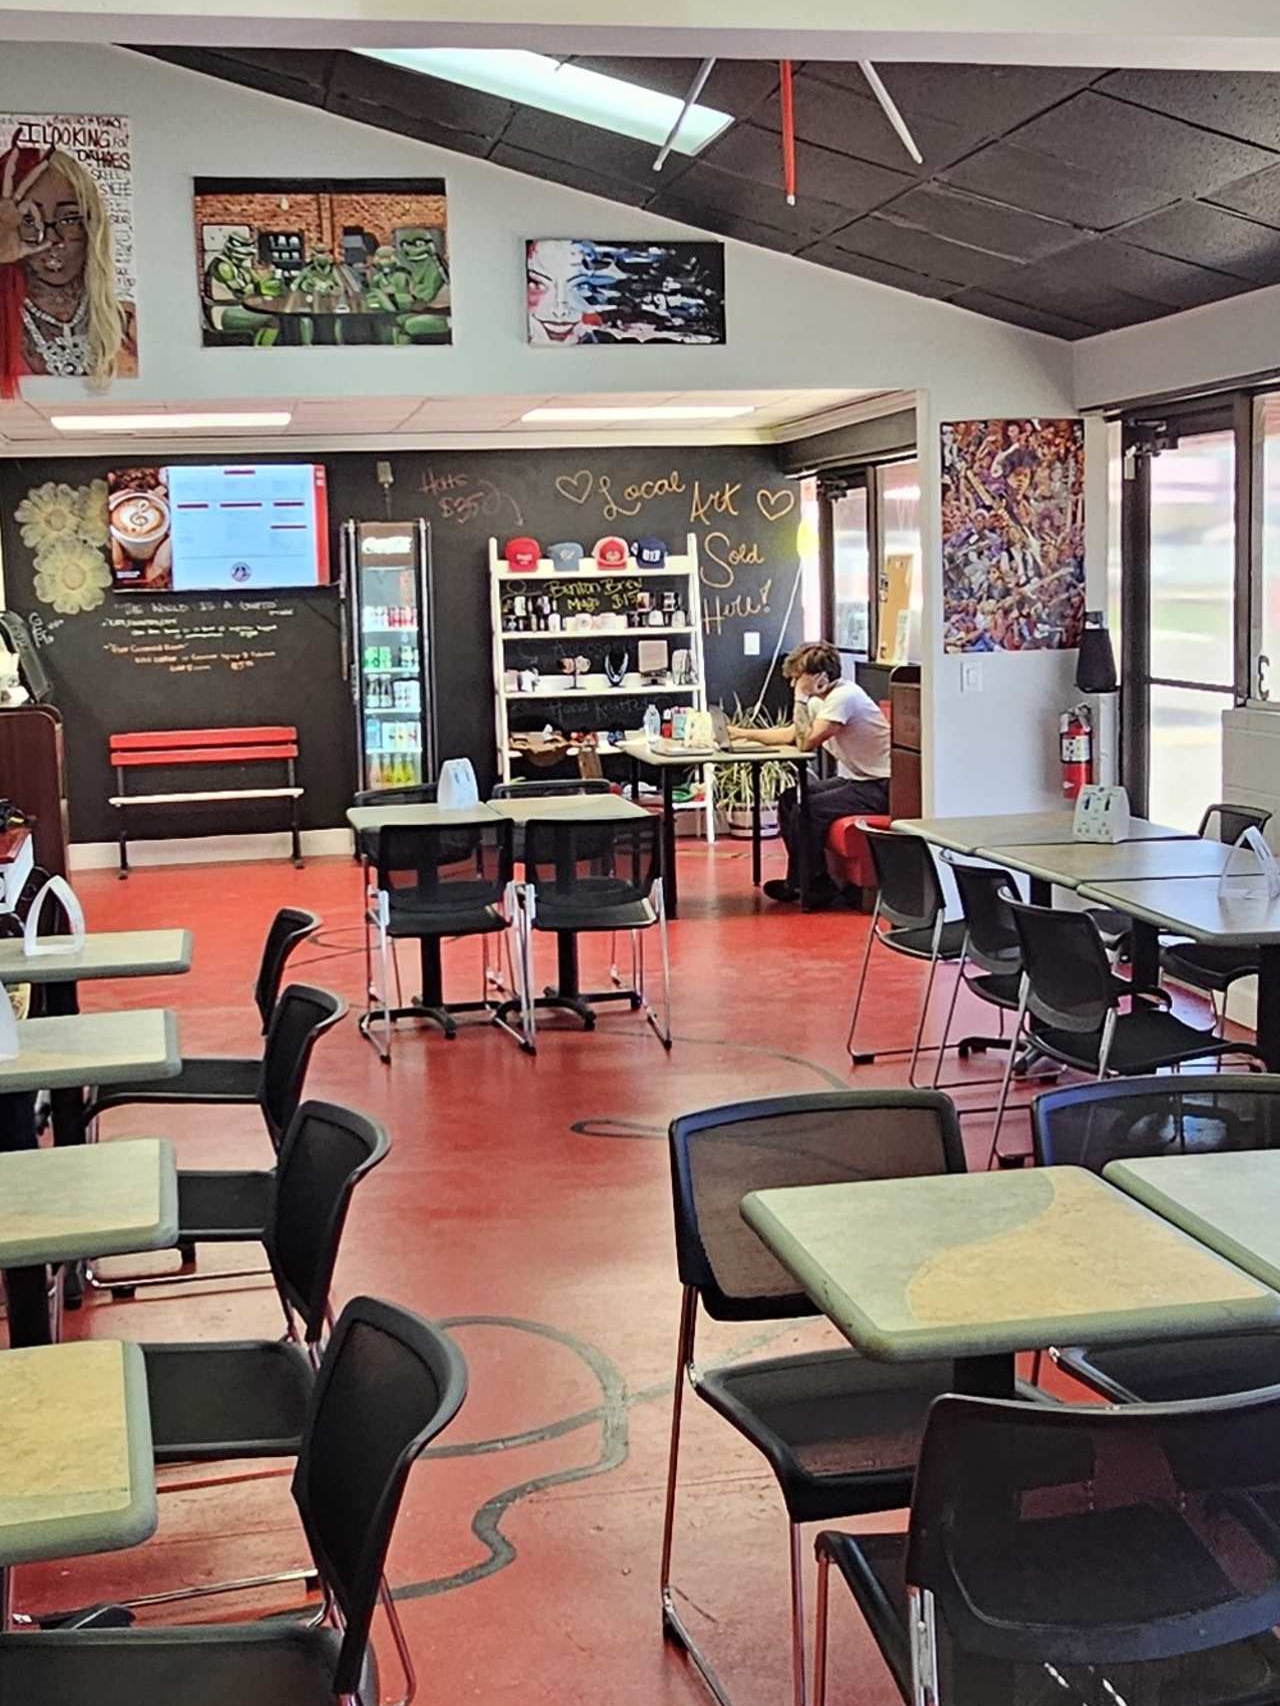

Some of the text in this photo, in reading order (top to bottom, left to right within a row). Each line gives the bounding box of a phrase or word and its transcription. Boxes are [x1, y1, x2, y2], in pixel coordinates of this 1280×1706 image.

[41, 125, 111, 149] LOOKING
[597, 470, 742, 525] Local Art
[699, 532, 766, 590] Sold
